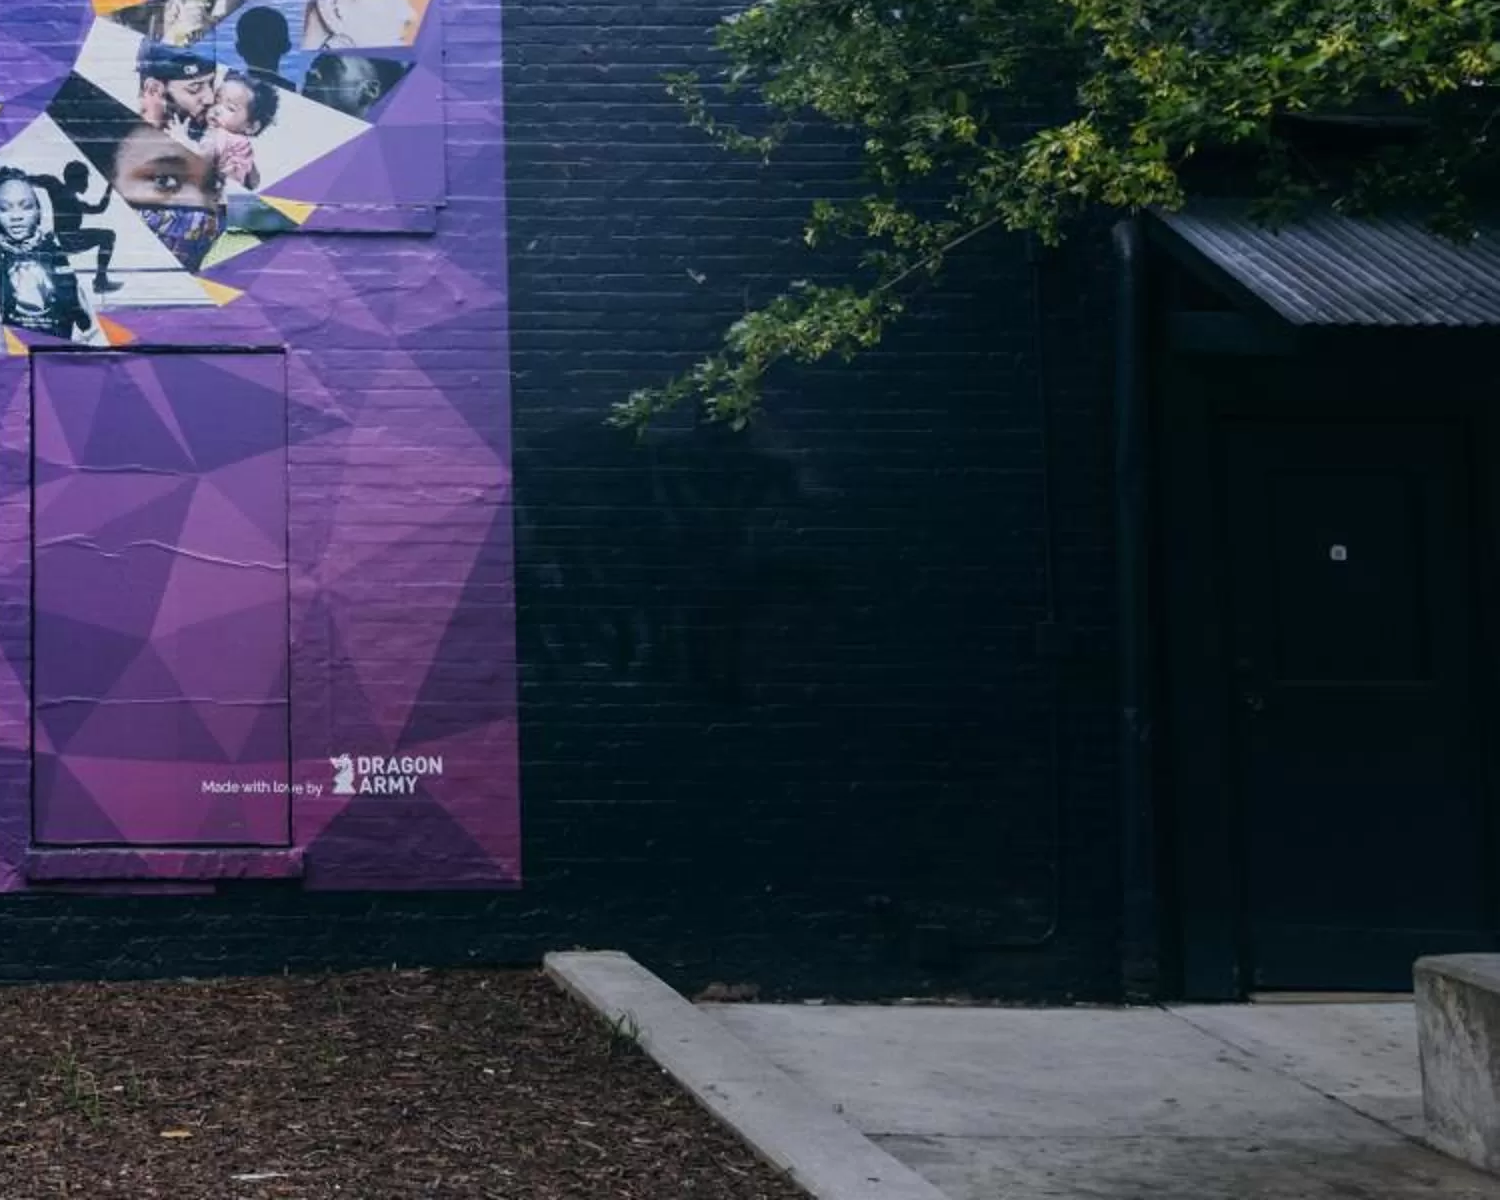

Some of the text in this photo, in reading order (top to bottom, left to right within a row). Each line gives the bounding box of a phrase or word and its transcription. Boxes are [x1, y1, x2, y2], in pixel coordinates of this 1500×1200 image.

[357, 756, 443, 775] DRAGON
[201, 780, 240, 794] Made
[242, 779, 271, 793] with
[305, 781, 324, 797] by
[359, 775, 418, 795] ARMY
